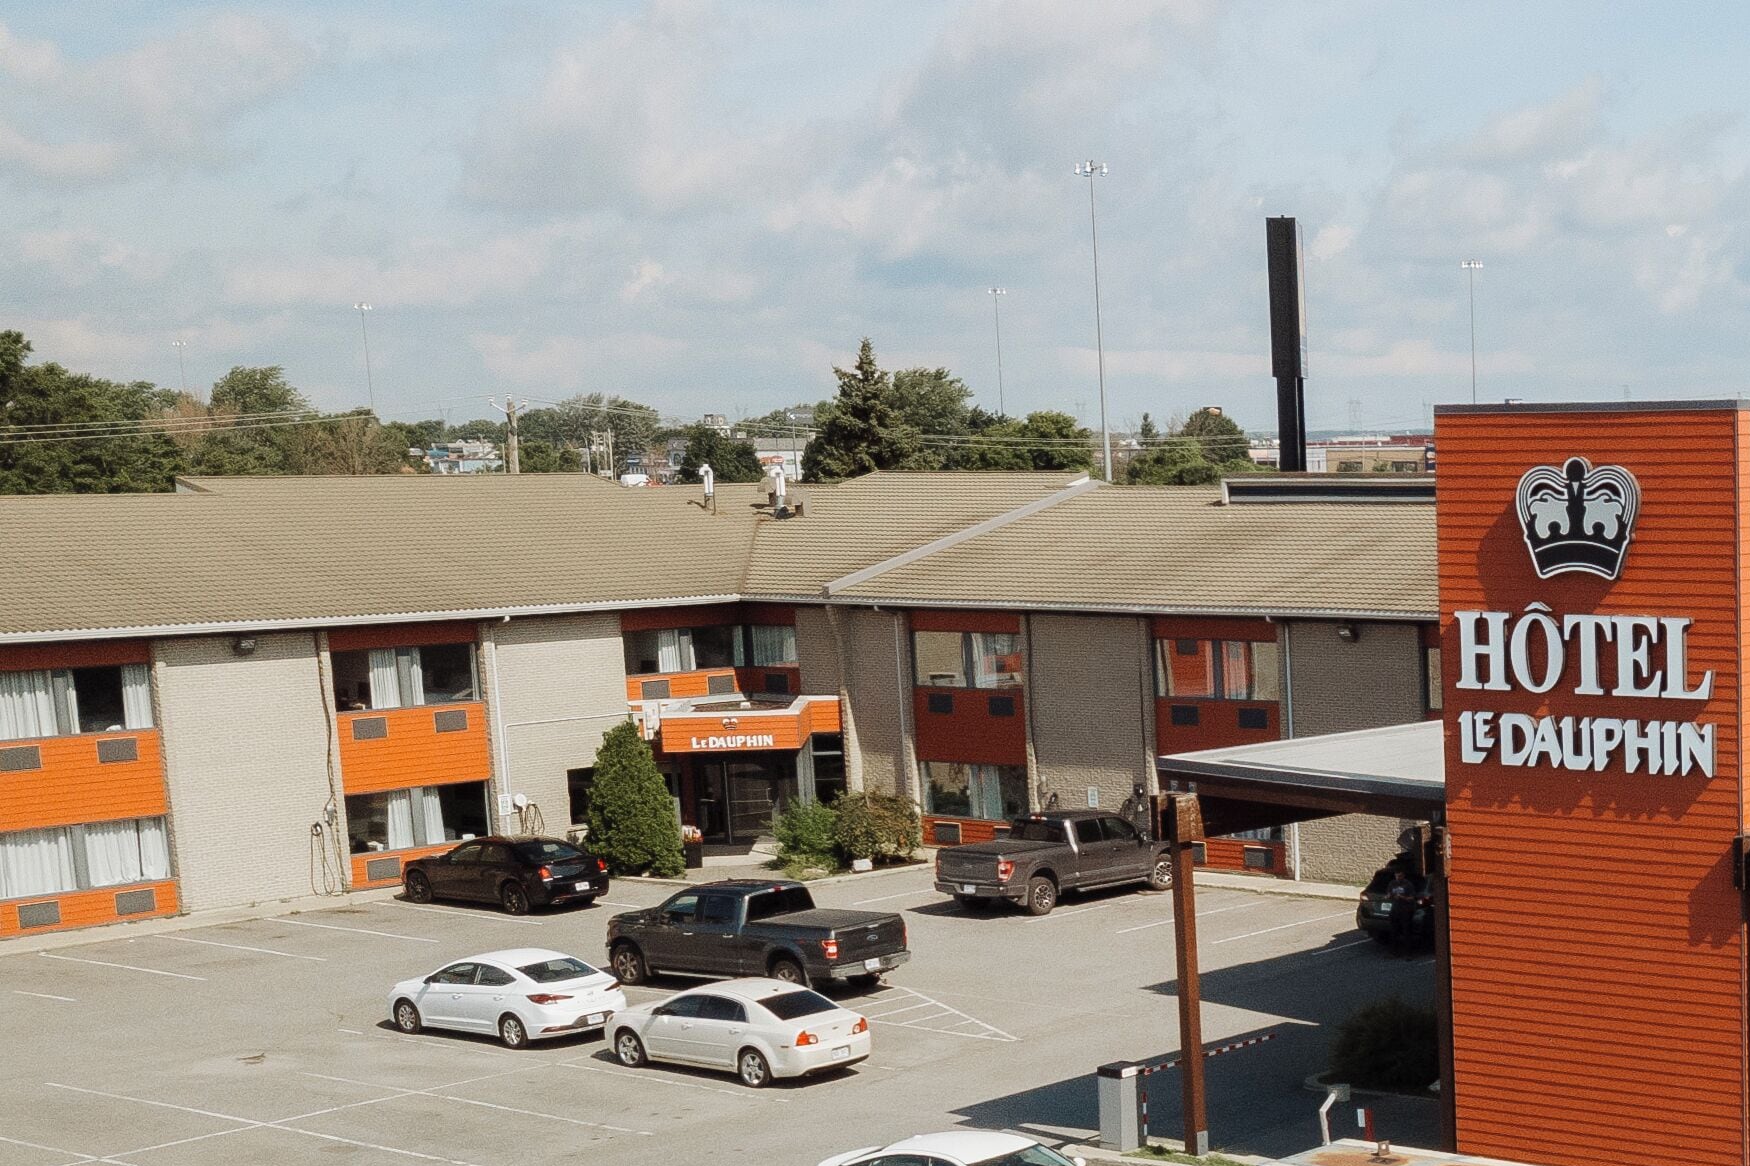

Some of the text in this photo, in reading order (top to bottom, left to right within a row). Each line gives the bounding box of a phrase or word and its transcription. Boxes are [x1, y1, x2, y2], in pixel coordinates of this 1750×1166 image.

[1454, 601, 1715, 700] HÔTEL
[708, 734, 774, 748] DAUPHIN
[1458, 711, 1717, 778] LE DAUPHIN
